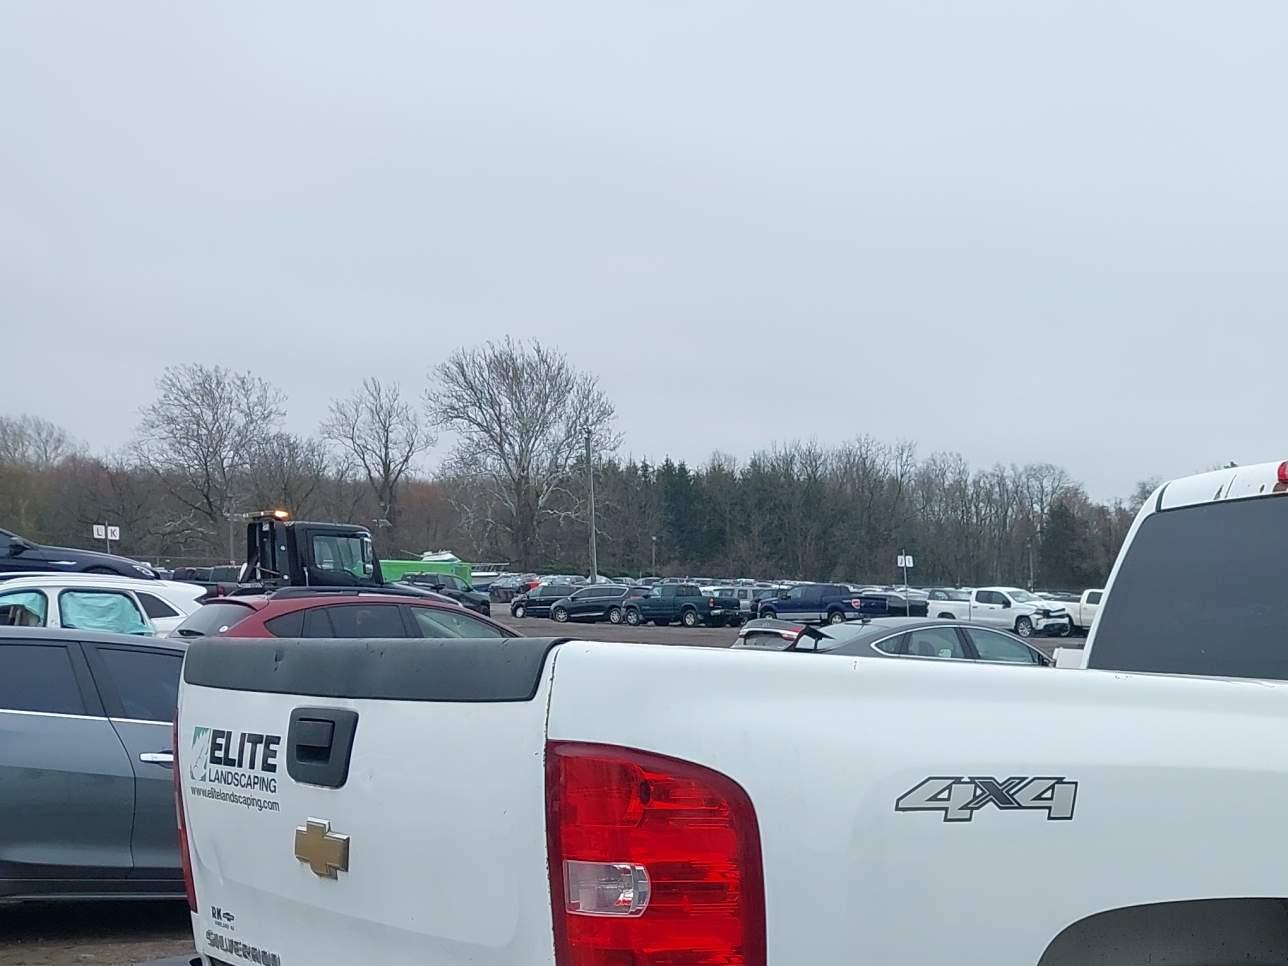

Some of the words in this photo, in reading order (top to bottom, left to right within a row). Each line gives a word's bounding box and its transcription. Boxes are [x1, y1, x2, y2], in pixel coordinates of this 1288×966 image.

[208, 728, 281, 774] ELITE
[208, 767, 277, 794] LANDSCAPING
[190, 785, 280, 812] www.elitelandscaping.com
